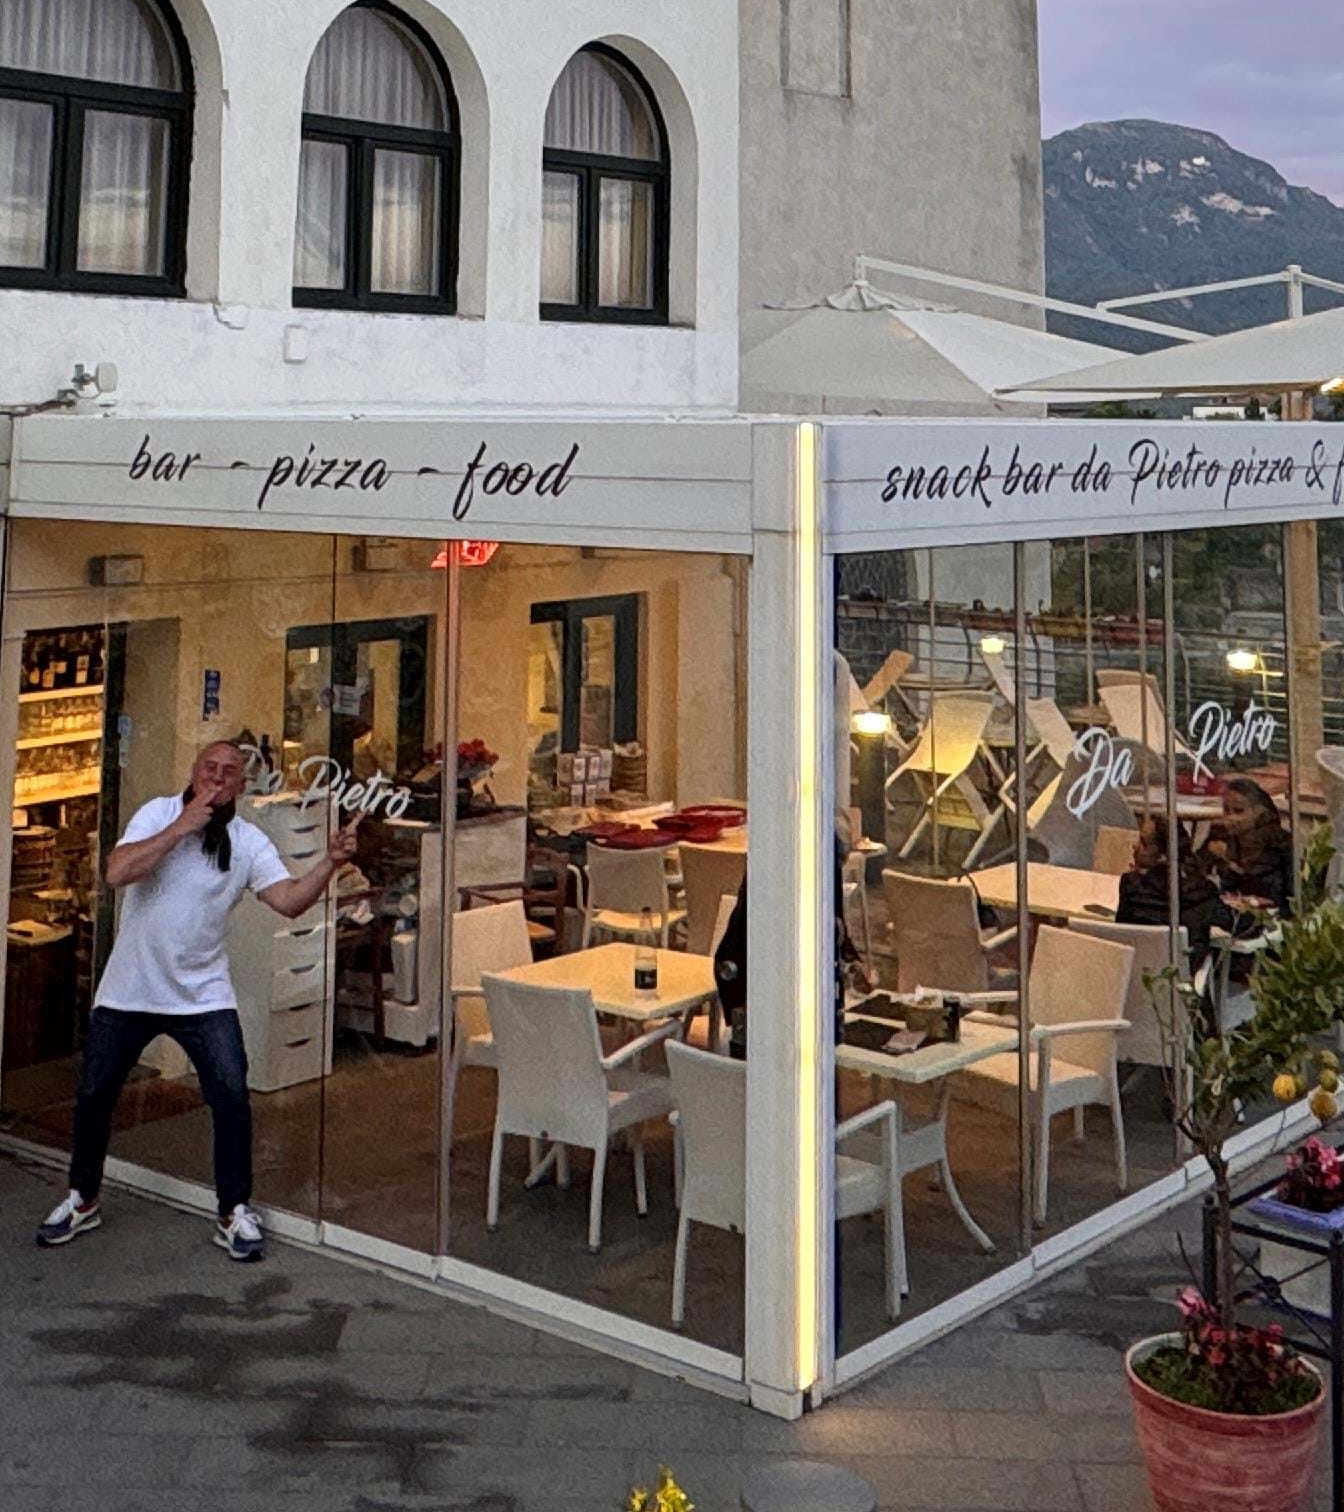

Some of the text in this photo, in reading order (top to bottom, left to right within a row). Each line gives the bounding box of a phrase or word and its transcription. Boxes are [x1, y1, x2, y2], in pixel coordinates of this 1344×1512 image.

[128, 433, 202, 482] bar
[257, 441, 392, 511] pizza
[452, 440, 580, 522] food
[880, 443, 993, 509] snack
[1002, 443, 1064, 496] bar
[1071, 442, 1113, 493] da
[1128, 438, 1223, 506] Pietro
[1223, 445, 1295, 509] pizza
[1306, 438, 1328, 491] &
[298, 754, 416, 819] Pietro
[1066, 697, 1280, 822] Da Pietro
